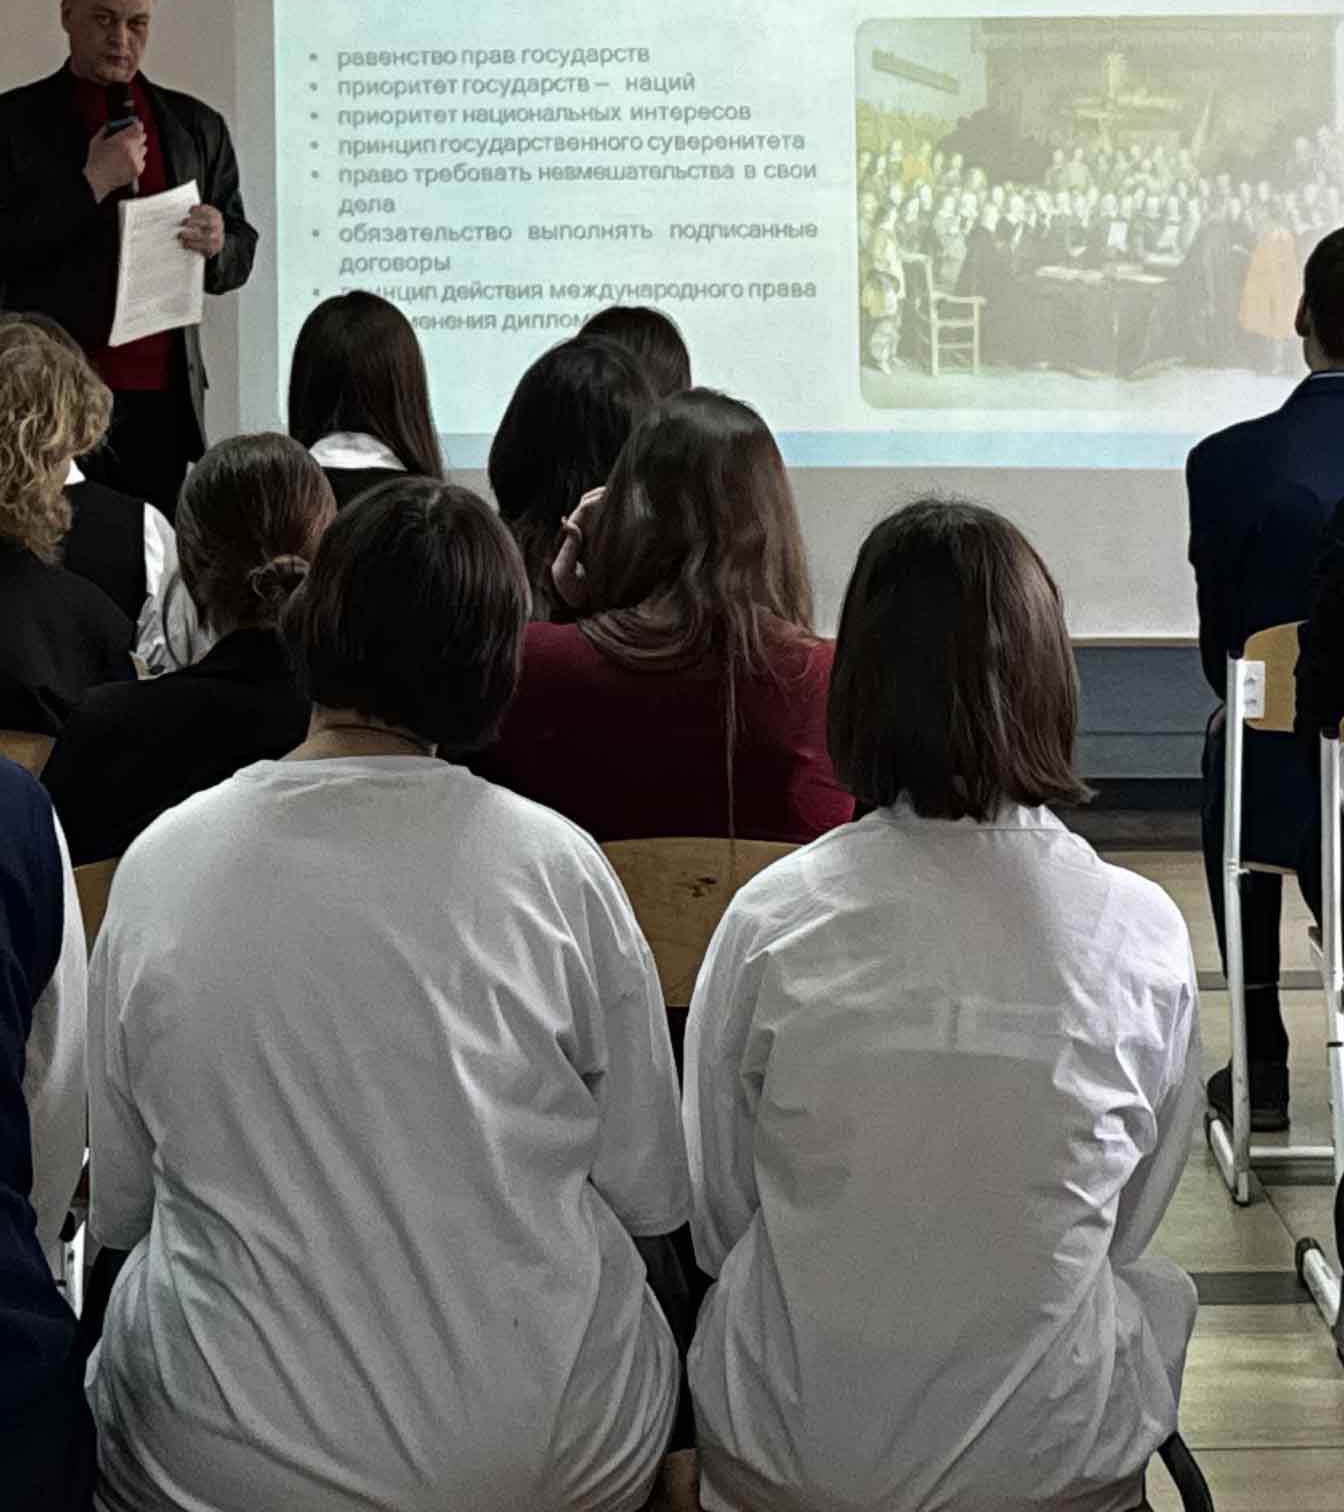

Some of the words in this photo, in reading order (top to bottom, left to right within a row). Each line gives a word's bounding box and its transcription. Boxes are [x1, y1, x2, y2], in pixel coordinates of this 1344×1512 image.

[337, 49, 456, 71] равенство
[461, 48, 515, 68] прав
[521, 47, 650, 68] государств
[337, 78, 457, 99] приоритет
[462, 77, 590, 98] государств
[625, 72, 695, 94] наций
[337, 107, 457, 128] приоритет
[463, 105, 622, 126] национальных
[630, 104, 751, 124] интересов
[338, 137, 436, 158] принцип
[440, 135, 642, 157] государственного
[647, 133, 806, 155] суверенитета
[338, 166, 407, 187] право
[413, 162, 532, 186] требовать
[538, 163, 735, 181] невмешательства
[744, 164, 756, 179] в
[763, 163, 817, 179] свои
[338, 197, 396, 217] дела
[339, 223, 513, 243] обязательство
[528, 223, 653, 240] выполнять
[669, 222, 818, 243] подписанные
[339, 255, 451, 275] договоры
[340, 285, 437, 303] нцип
[441, 281, 543, 303] действия
[549, 282, 744, 304] международного
[748, 281, 817, 302] права
